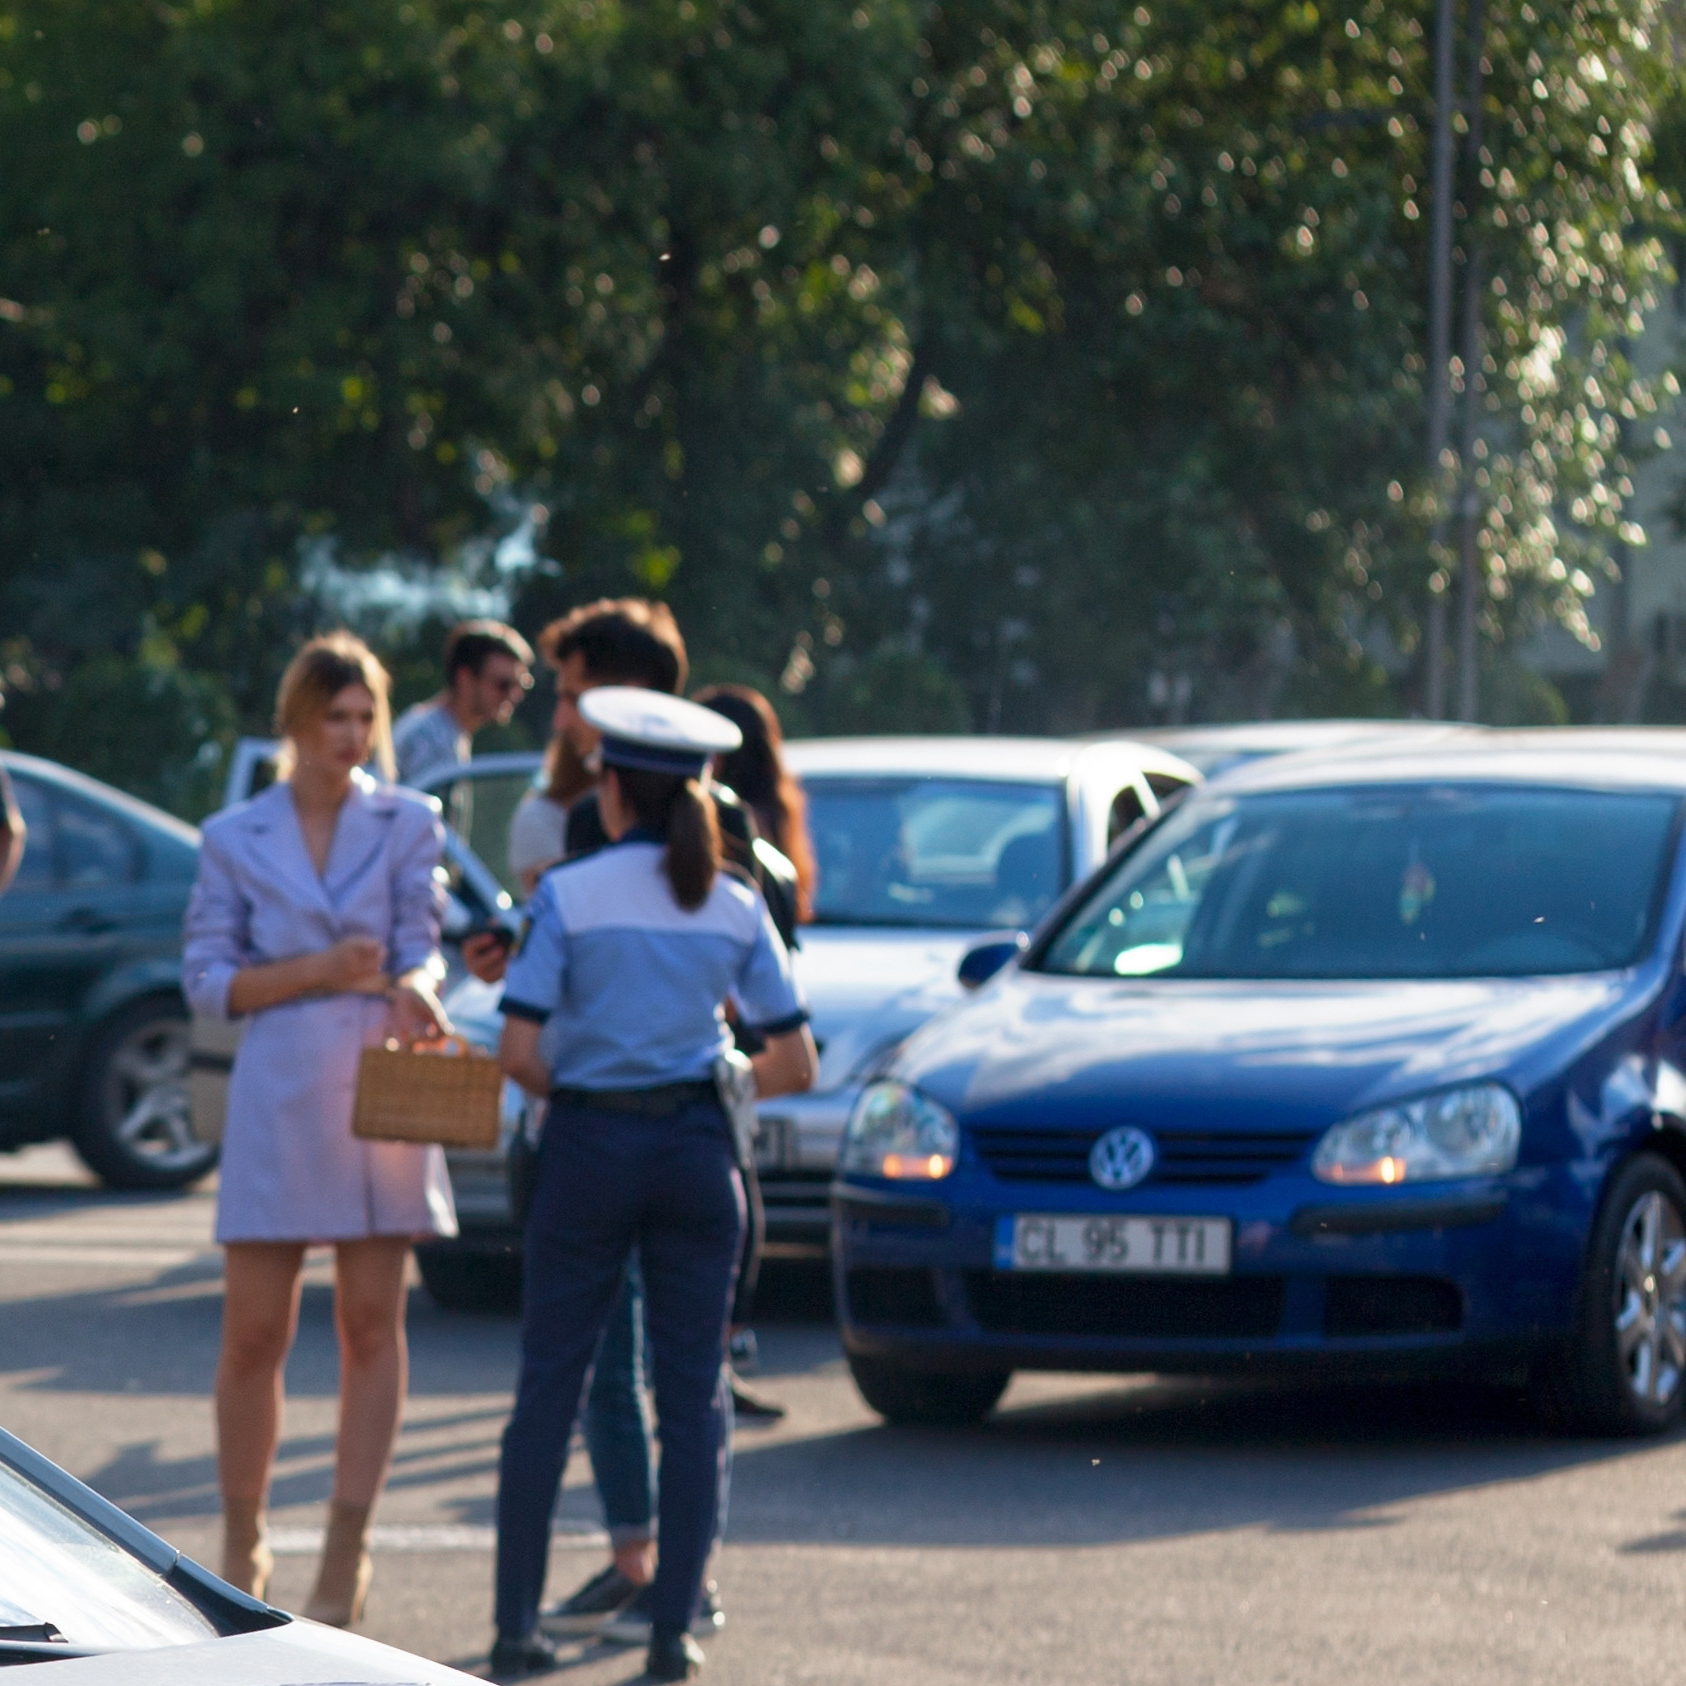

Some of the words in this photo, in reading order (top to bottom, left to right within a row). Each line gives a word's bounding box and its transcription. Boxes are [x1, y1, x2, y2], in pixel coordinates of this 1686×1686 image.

[1019, 1219, 1064, 1261] CL
[1083, 1218, 1129, 1261] 95
[1149, 1222, 1206, 1262] TTI
